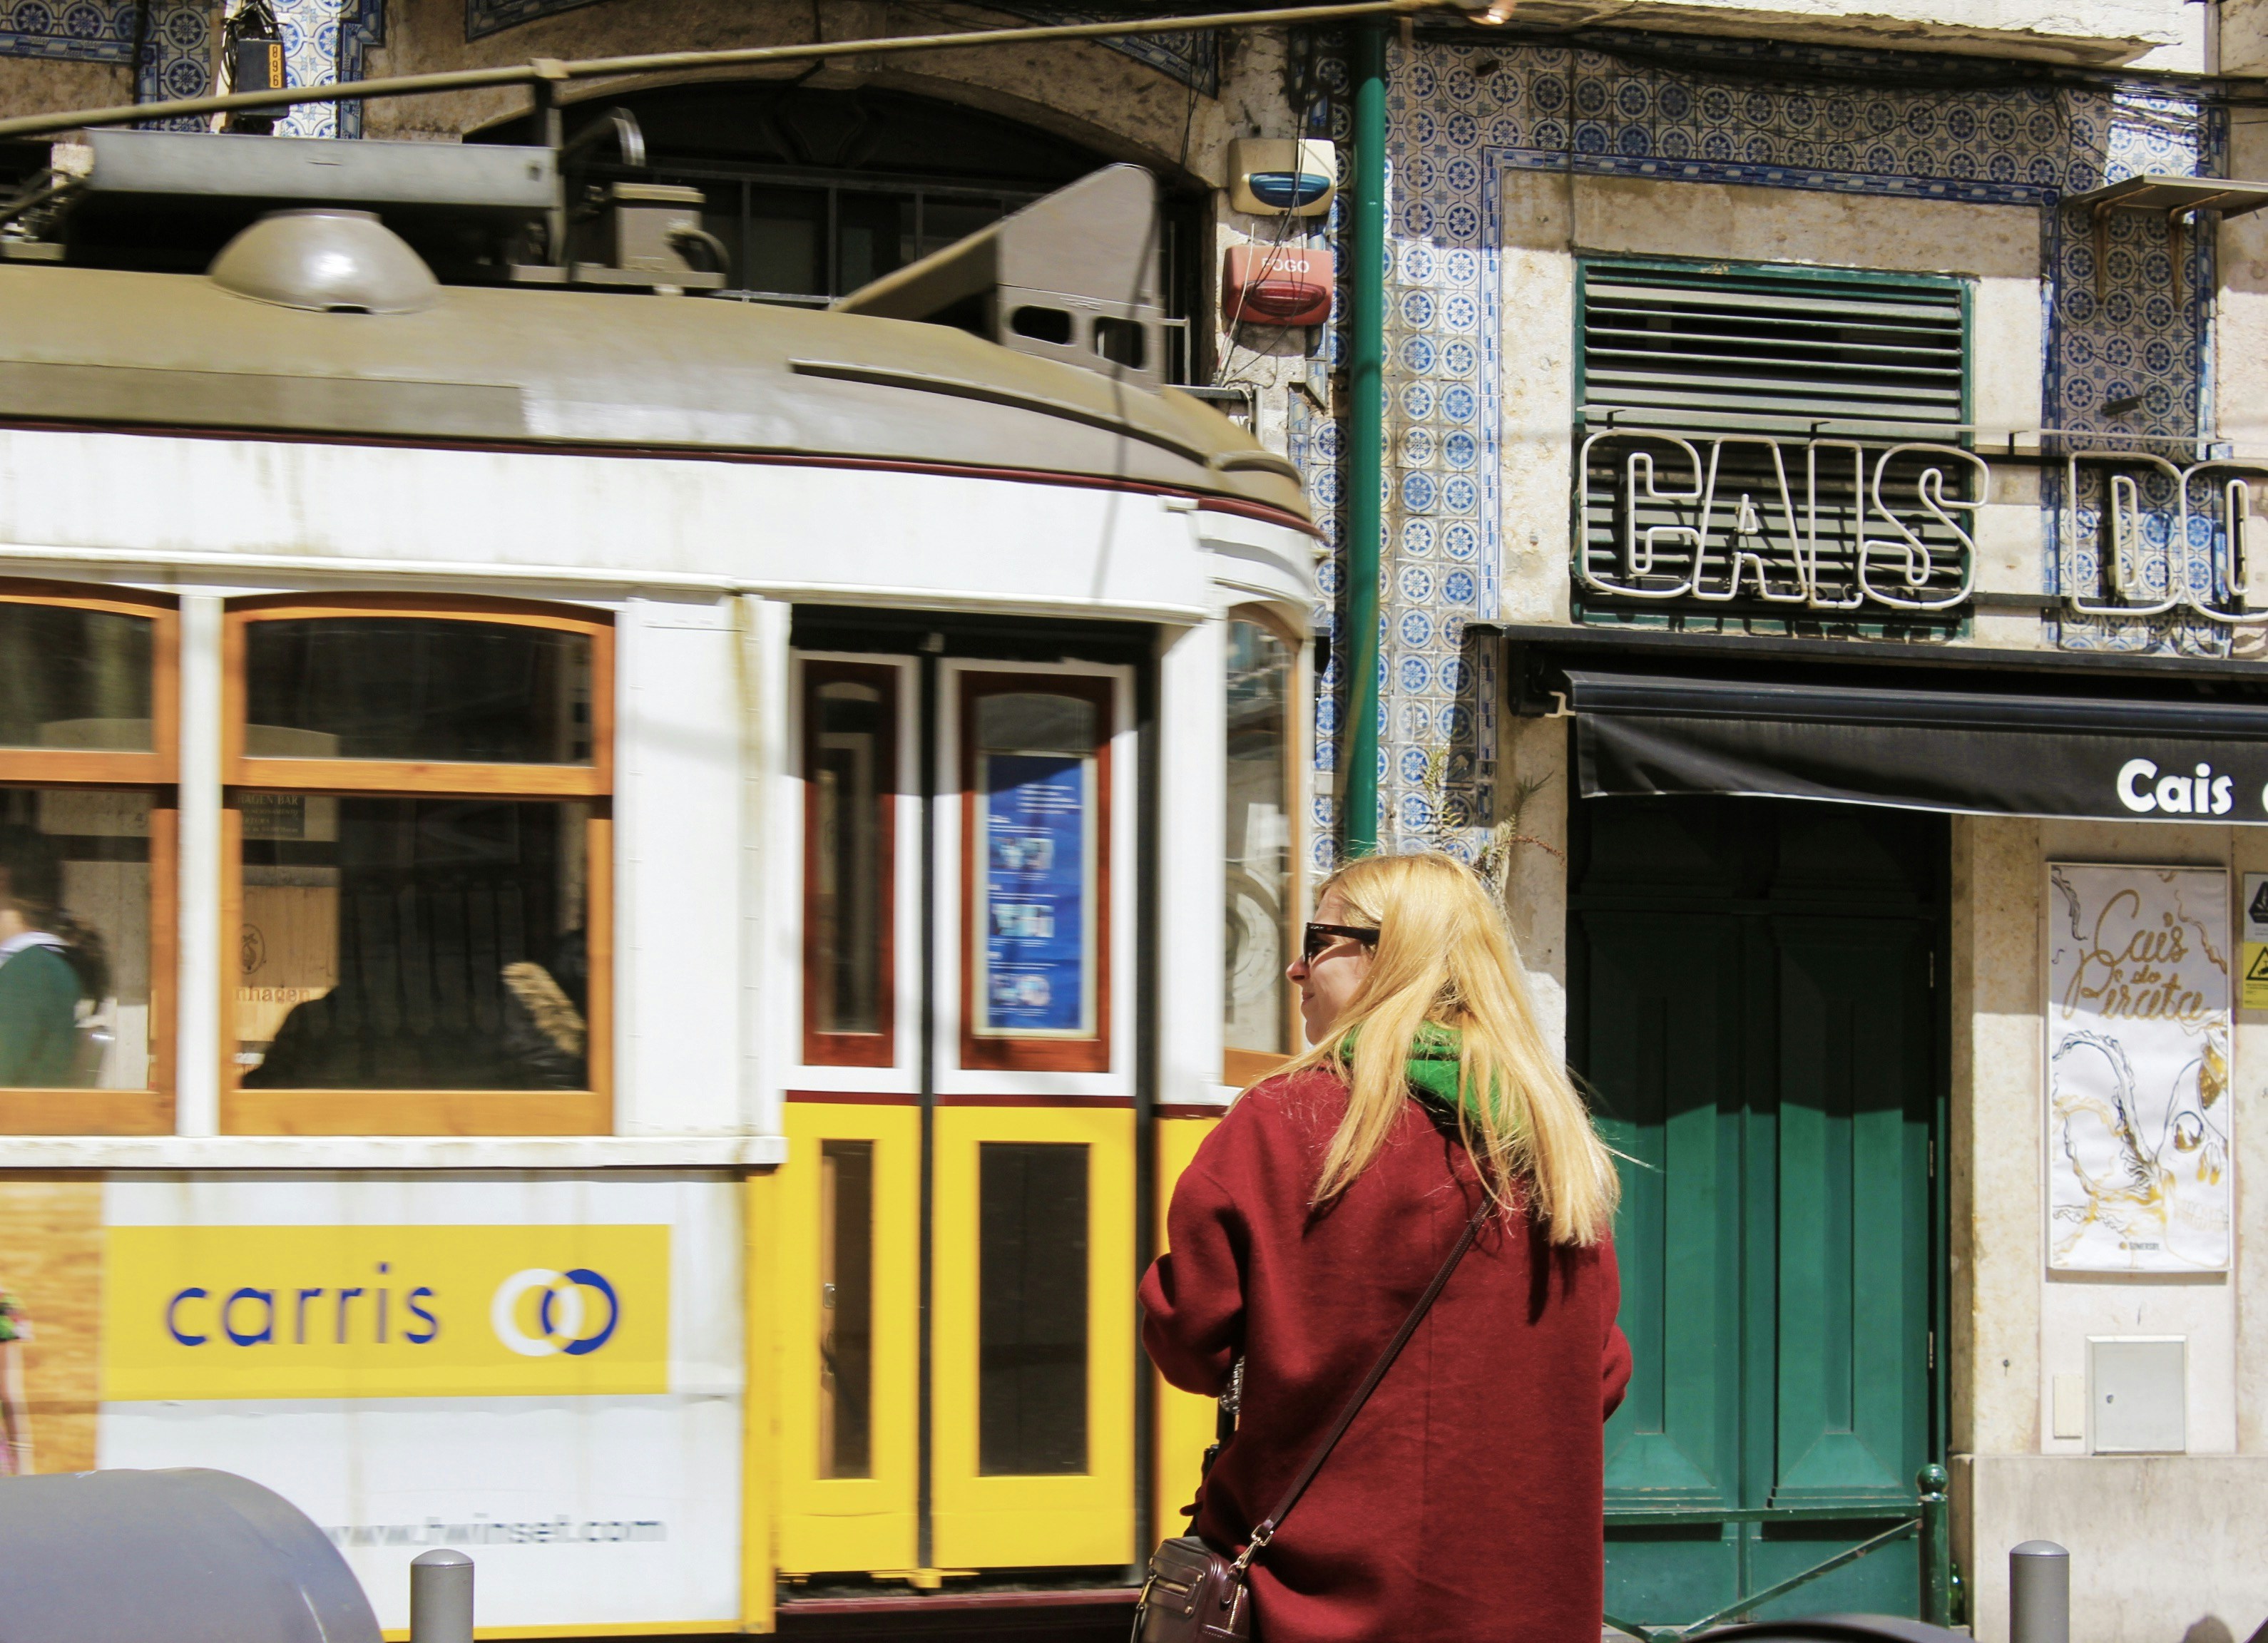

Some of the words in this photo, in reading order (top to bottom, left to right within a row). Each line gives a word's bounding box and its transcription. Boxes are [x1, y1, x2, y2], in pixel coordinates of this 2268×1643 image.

[1261, 257, 1309, 273] FOGO
[1580, 428, 1991, 610] CAIS
[2117, 758, 2233, 815] Cais
[2094, 889, 2188, 966] Cais
[2062, 946, 2211, 1020] Pirata
[2130, 964, 2162, 984] do
[165, 1261, 439, 1346] carris
